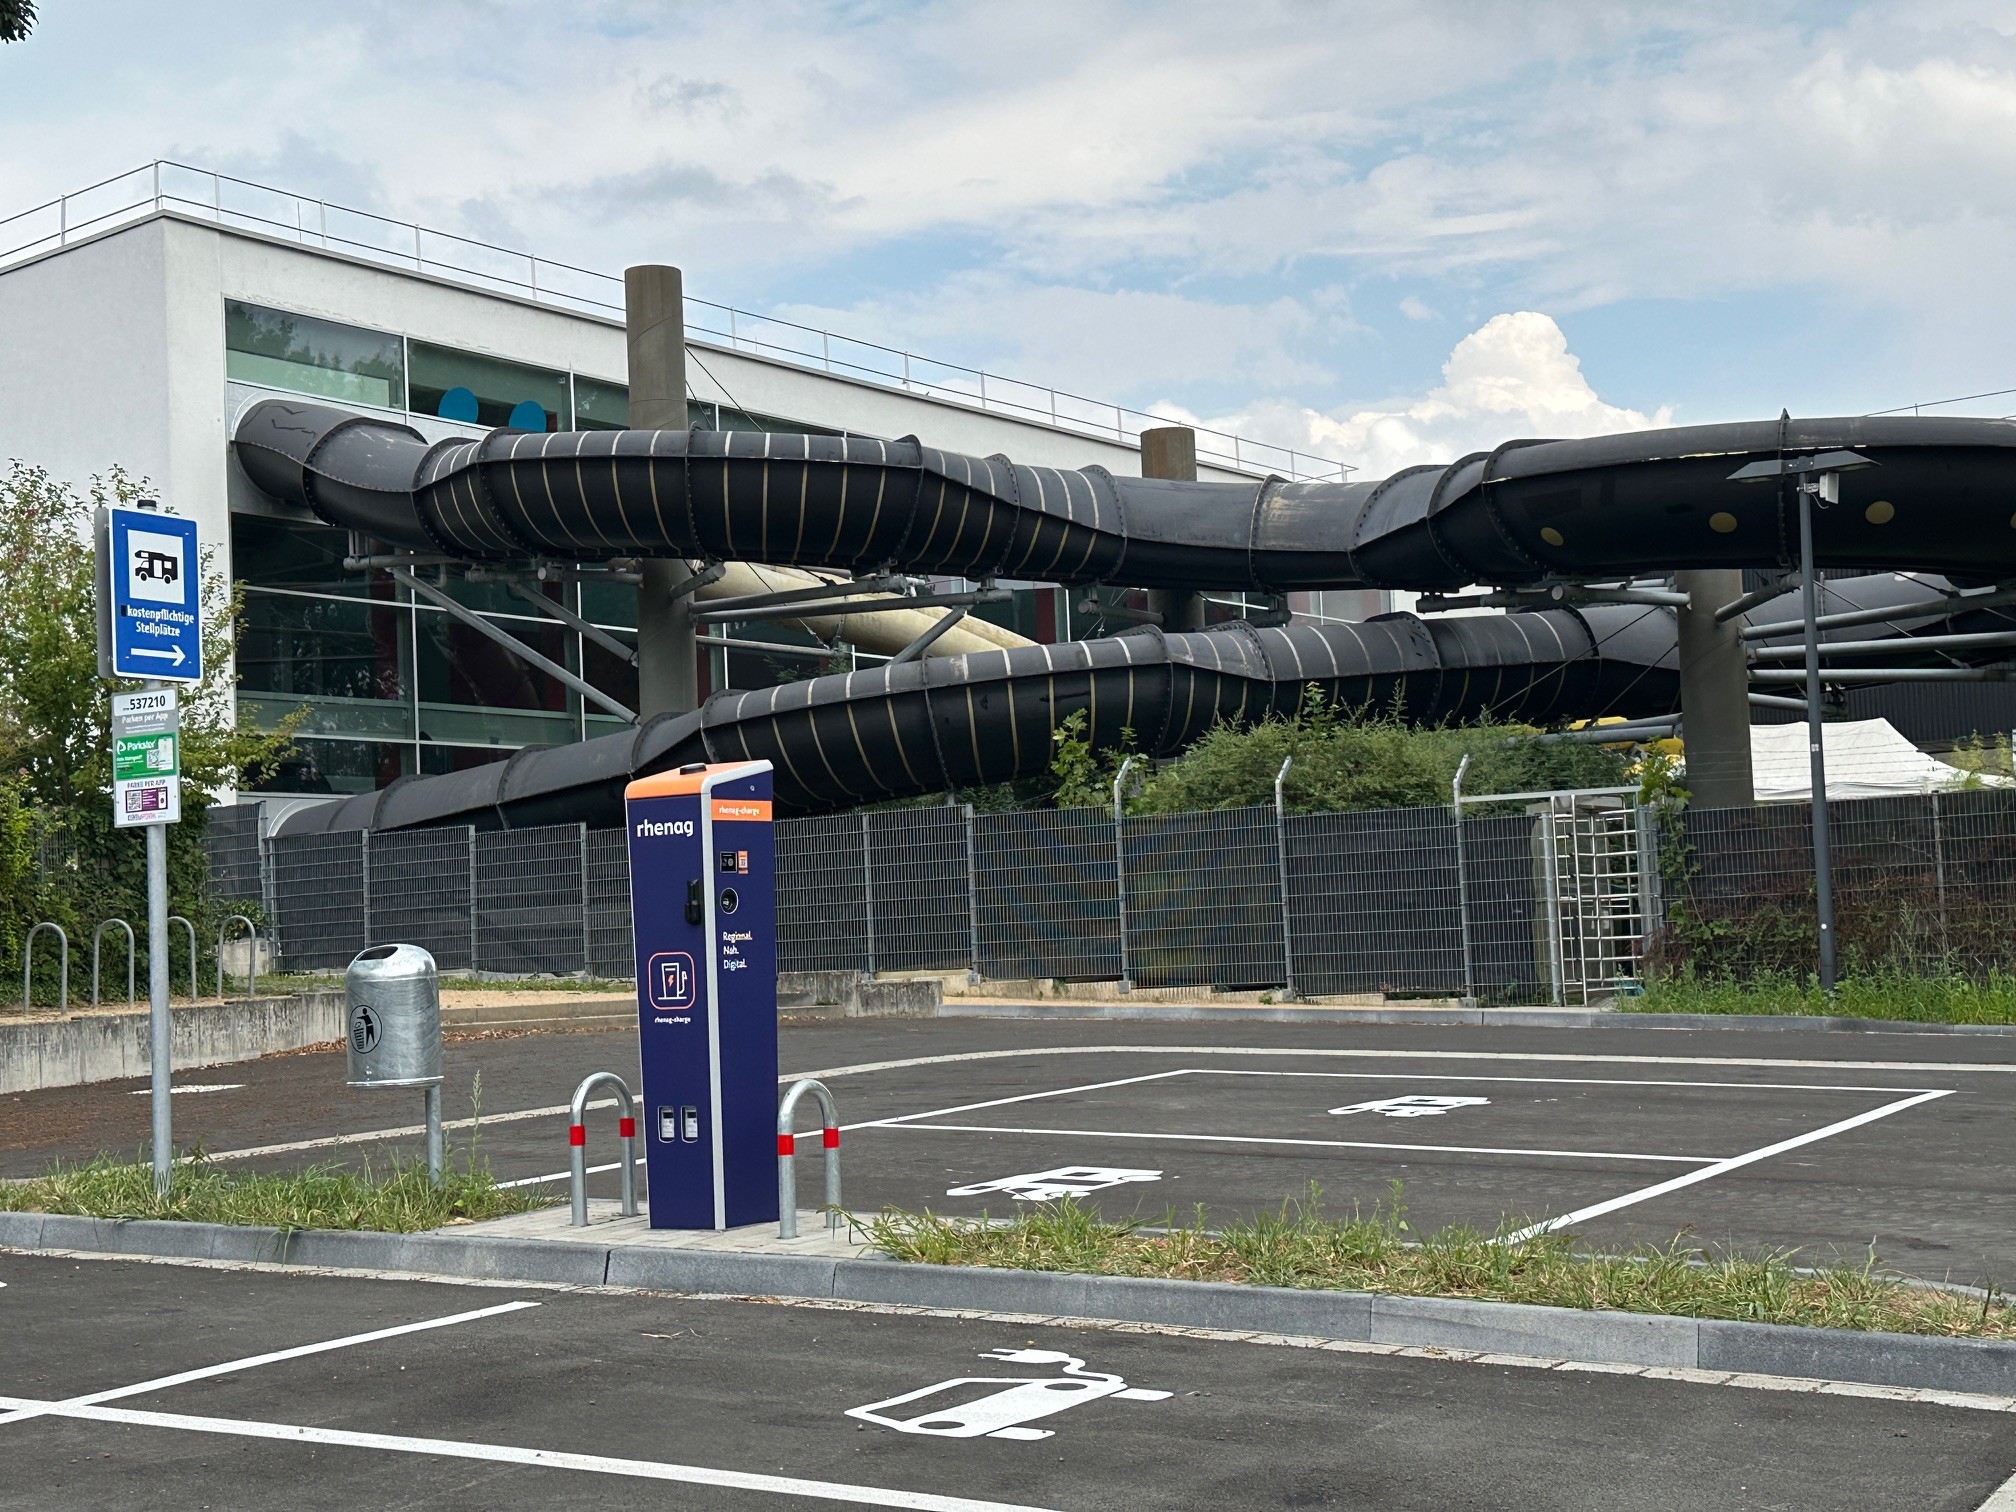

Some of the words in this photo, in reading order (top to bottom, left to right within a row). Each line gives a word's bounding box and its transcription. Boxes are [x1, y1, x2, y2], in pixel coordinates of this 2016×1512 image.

[127, 604, 195, 626] kostenpflichtige
[135, 621, 181, 637] Stellplätze
[129, 695, 166, 710] 537210
[719, 805, 760, 816] rhenag-charge
[637, 819, 694, 837] rhenag
